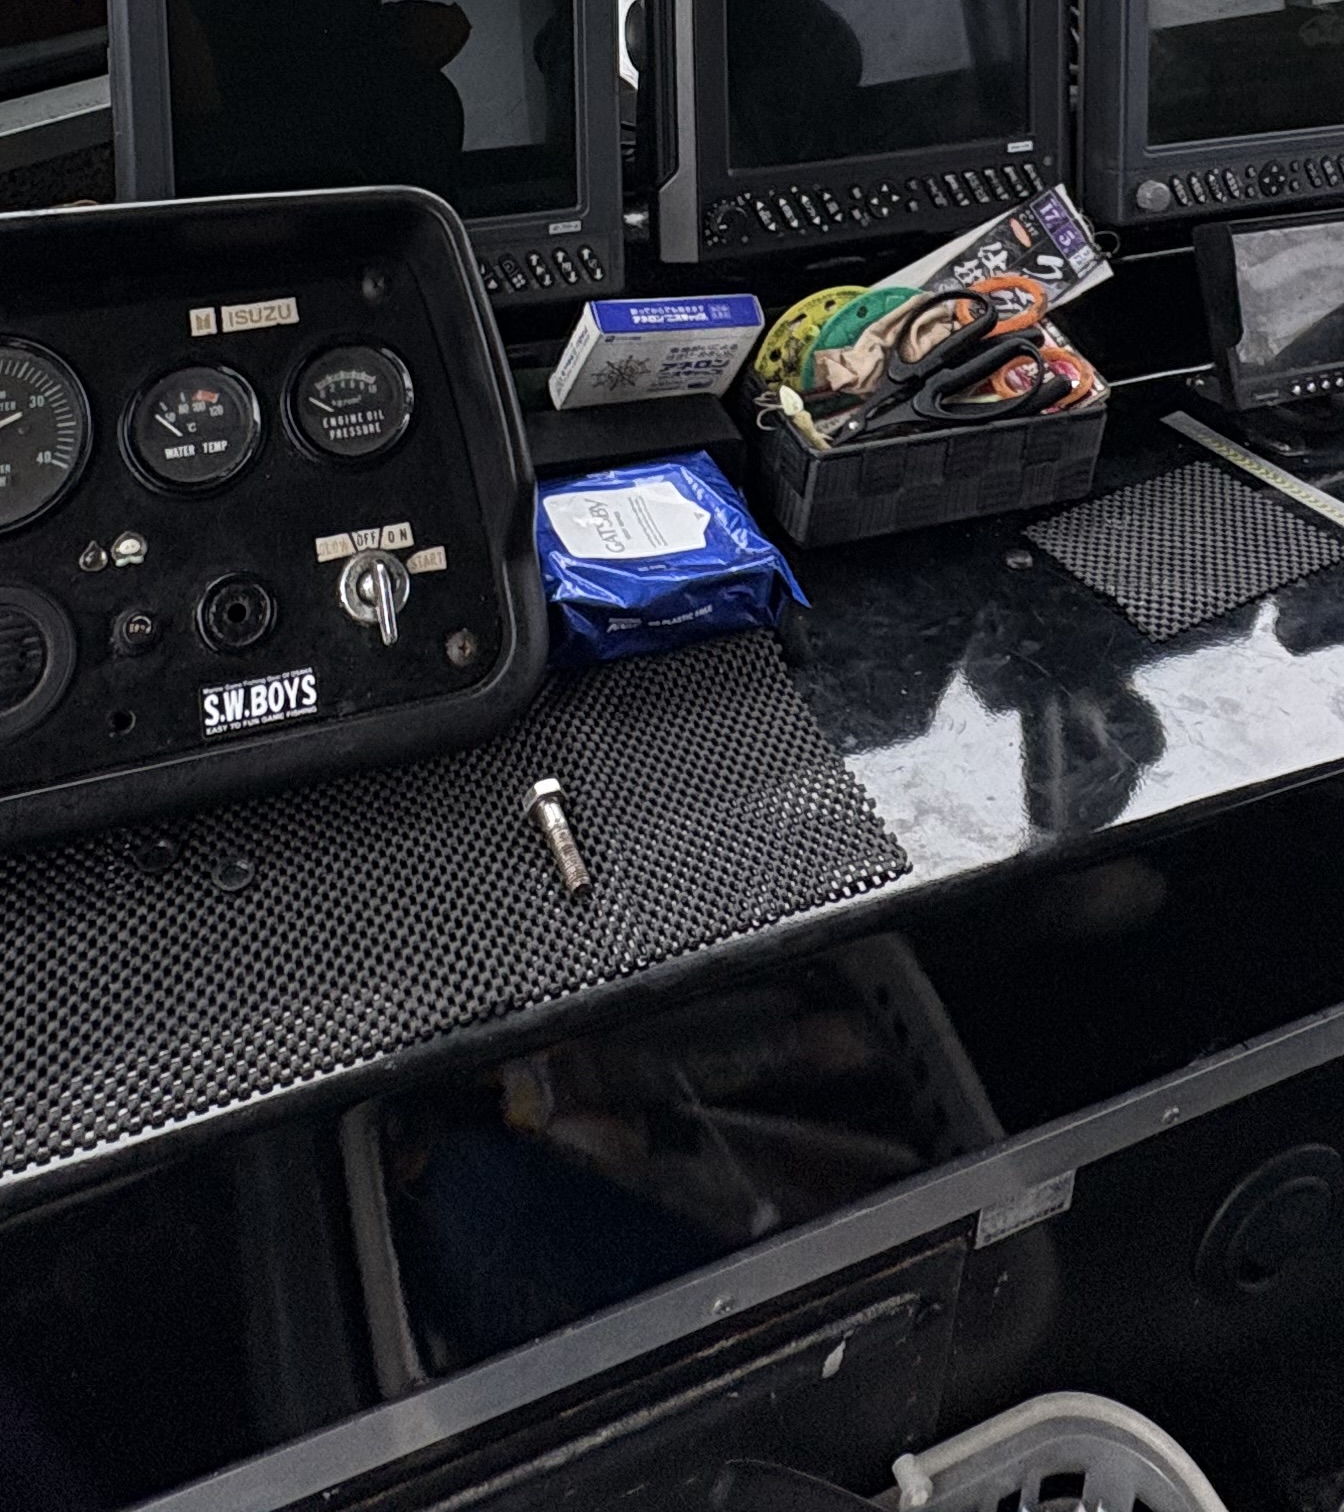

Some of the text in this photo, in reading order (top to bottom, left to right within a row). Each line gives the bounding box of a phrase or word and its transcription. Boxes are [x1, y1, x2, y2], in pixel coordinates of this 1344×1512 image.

[1040, 201, 1076, 247] 17 5
[228, 303, 292, 328] ISUZU
[29, 395, 45, 408] 30
[209, 405, 224, 417] 120
[323, 409, 385, 429] ENGINE OIL
[329, 422, 381, 441] PRESSURE
[36, 451, 52, 465] 40
[164, 440, 228, 460] WATER TEMP
[584, 498, 626, 553] GATSBY
[357, 531, 376, 547] OFF
[411, 552, 444, 570] START
[203, 674, 317, 727] S.W.BOYS
[205, 704, 318, 736] EASY TO FUN GAME FISHING
